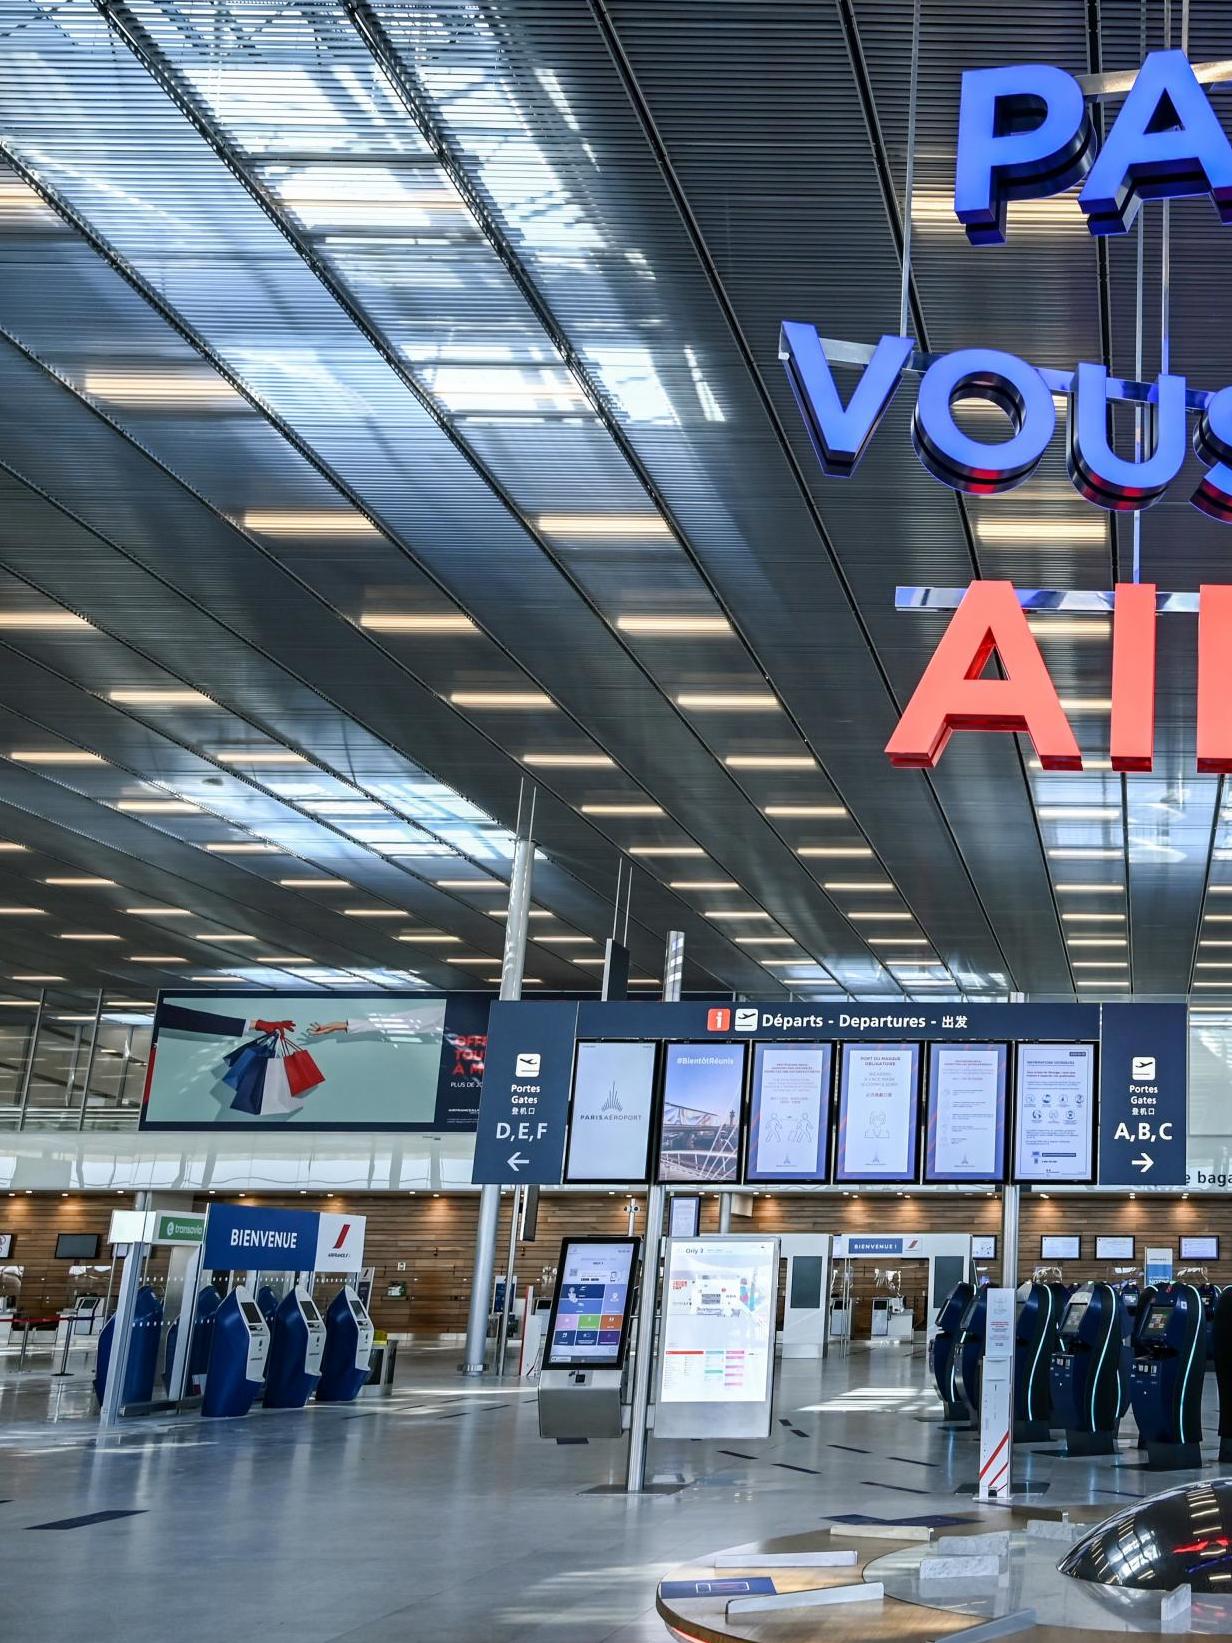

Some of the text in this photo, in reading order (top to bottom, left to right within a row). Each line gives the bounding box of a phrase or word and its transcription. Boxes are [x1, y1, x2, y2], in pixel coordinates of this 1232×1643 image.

[762, 1013, 823, 1029] Départs
[839, 1014, 926, 1030] Departures
[941, 1015, 968, 1029] 出发
[511, 1084, 541, 1093] Portes
[1129, 1084, 1158, 1094] Portes
[511, 1095, 538, 1104] Gates
[1130, 1095, 1157, 1104] Gates
[1131, 1107, 1155, 1116] 登机口
[496, 1122, 548, 1142] D,E,F
[1114, 1122, 1173, 1142] A,B,C
[230, 1228, 298, 1249] BIENVENUE
